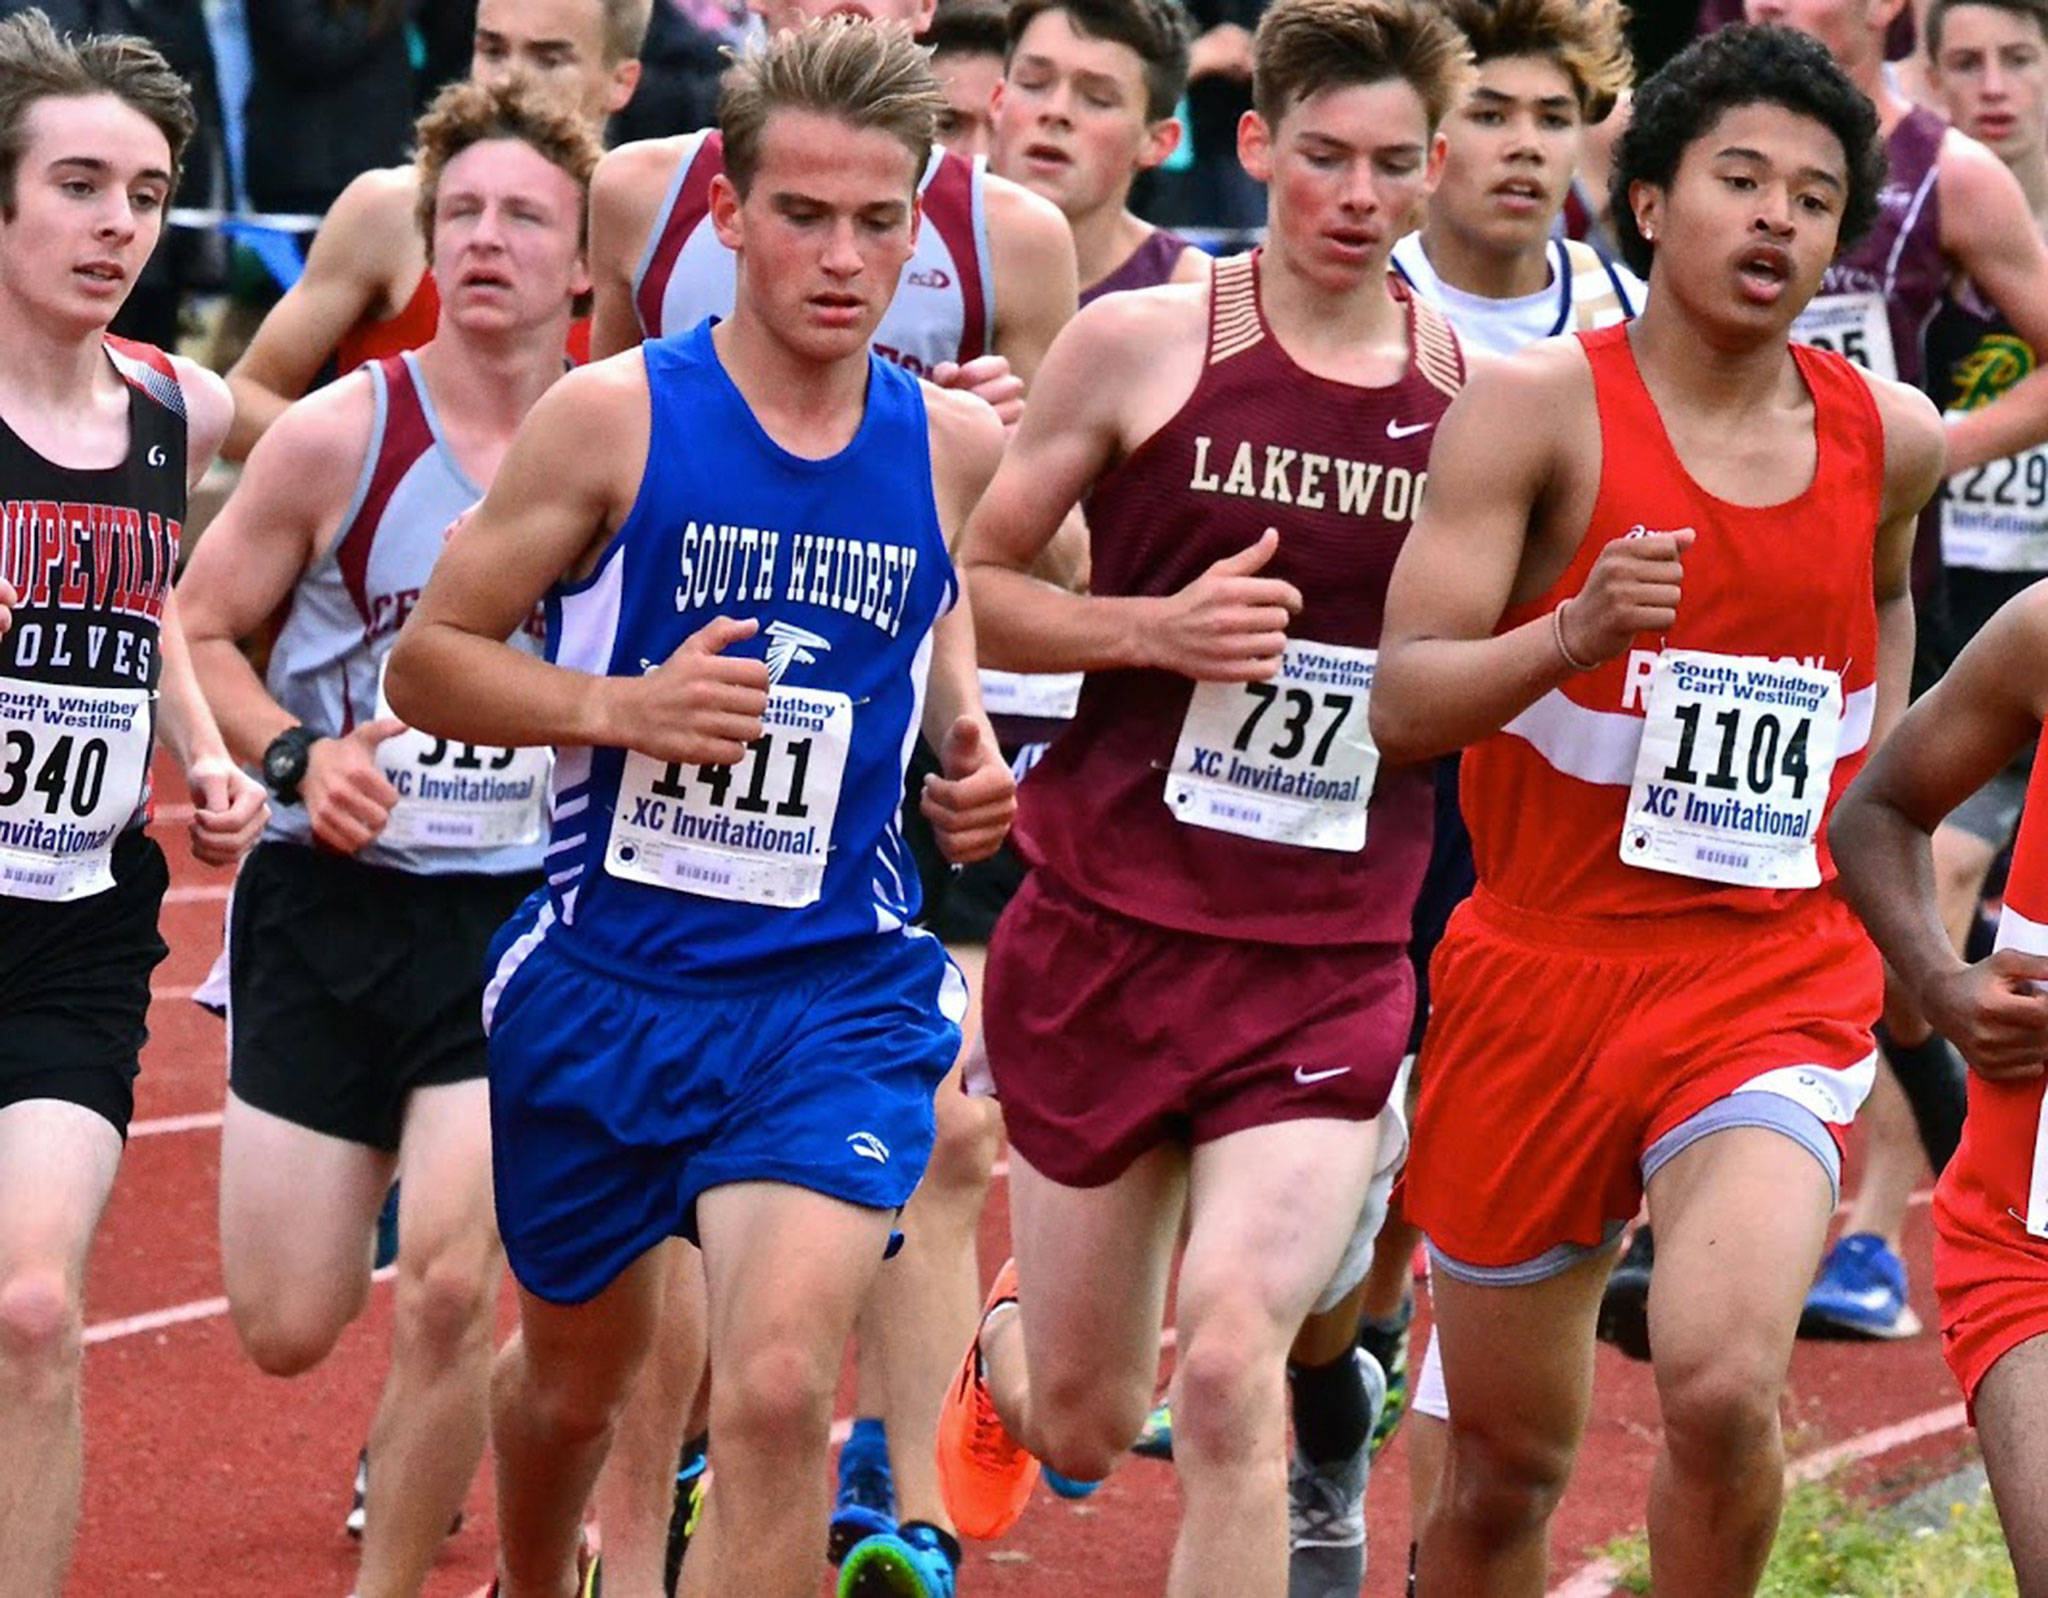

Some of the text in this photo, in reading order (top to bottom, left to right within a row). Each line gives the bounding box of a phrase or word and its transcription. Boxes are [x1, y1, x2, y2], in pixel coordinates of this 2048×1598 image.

[1190, 436, 1429, 523] LAKEWO
[1943, 453, 2047, 507] 229
[675, 521, 918, 638] SOUTH WHIDBEY
[14, 623, 151, 682] OLVES
[1298, 652, 1375, 675] Whidbe
[0, 692, 140, 717] outh Whidbey
[1671, 661, 1739, 684] South
[1747, 671, 1830, 699] Whidbey
[1677, 676, 1821, 713] Carl Westling
[0, 702, 133, 733] arl Westling
[1232, 682, 1354, 768] 737
[1188, 747, 1360, 803] XC Invitational
[1662, 702, 1812, 800] 1104
[419, 773, 535, 803] Invitational
[1641, 784, 1812, 839] XC Invitational
[0, 818, 117, 856] nvitational
[630, 796, 817, 856] XC Invitational
